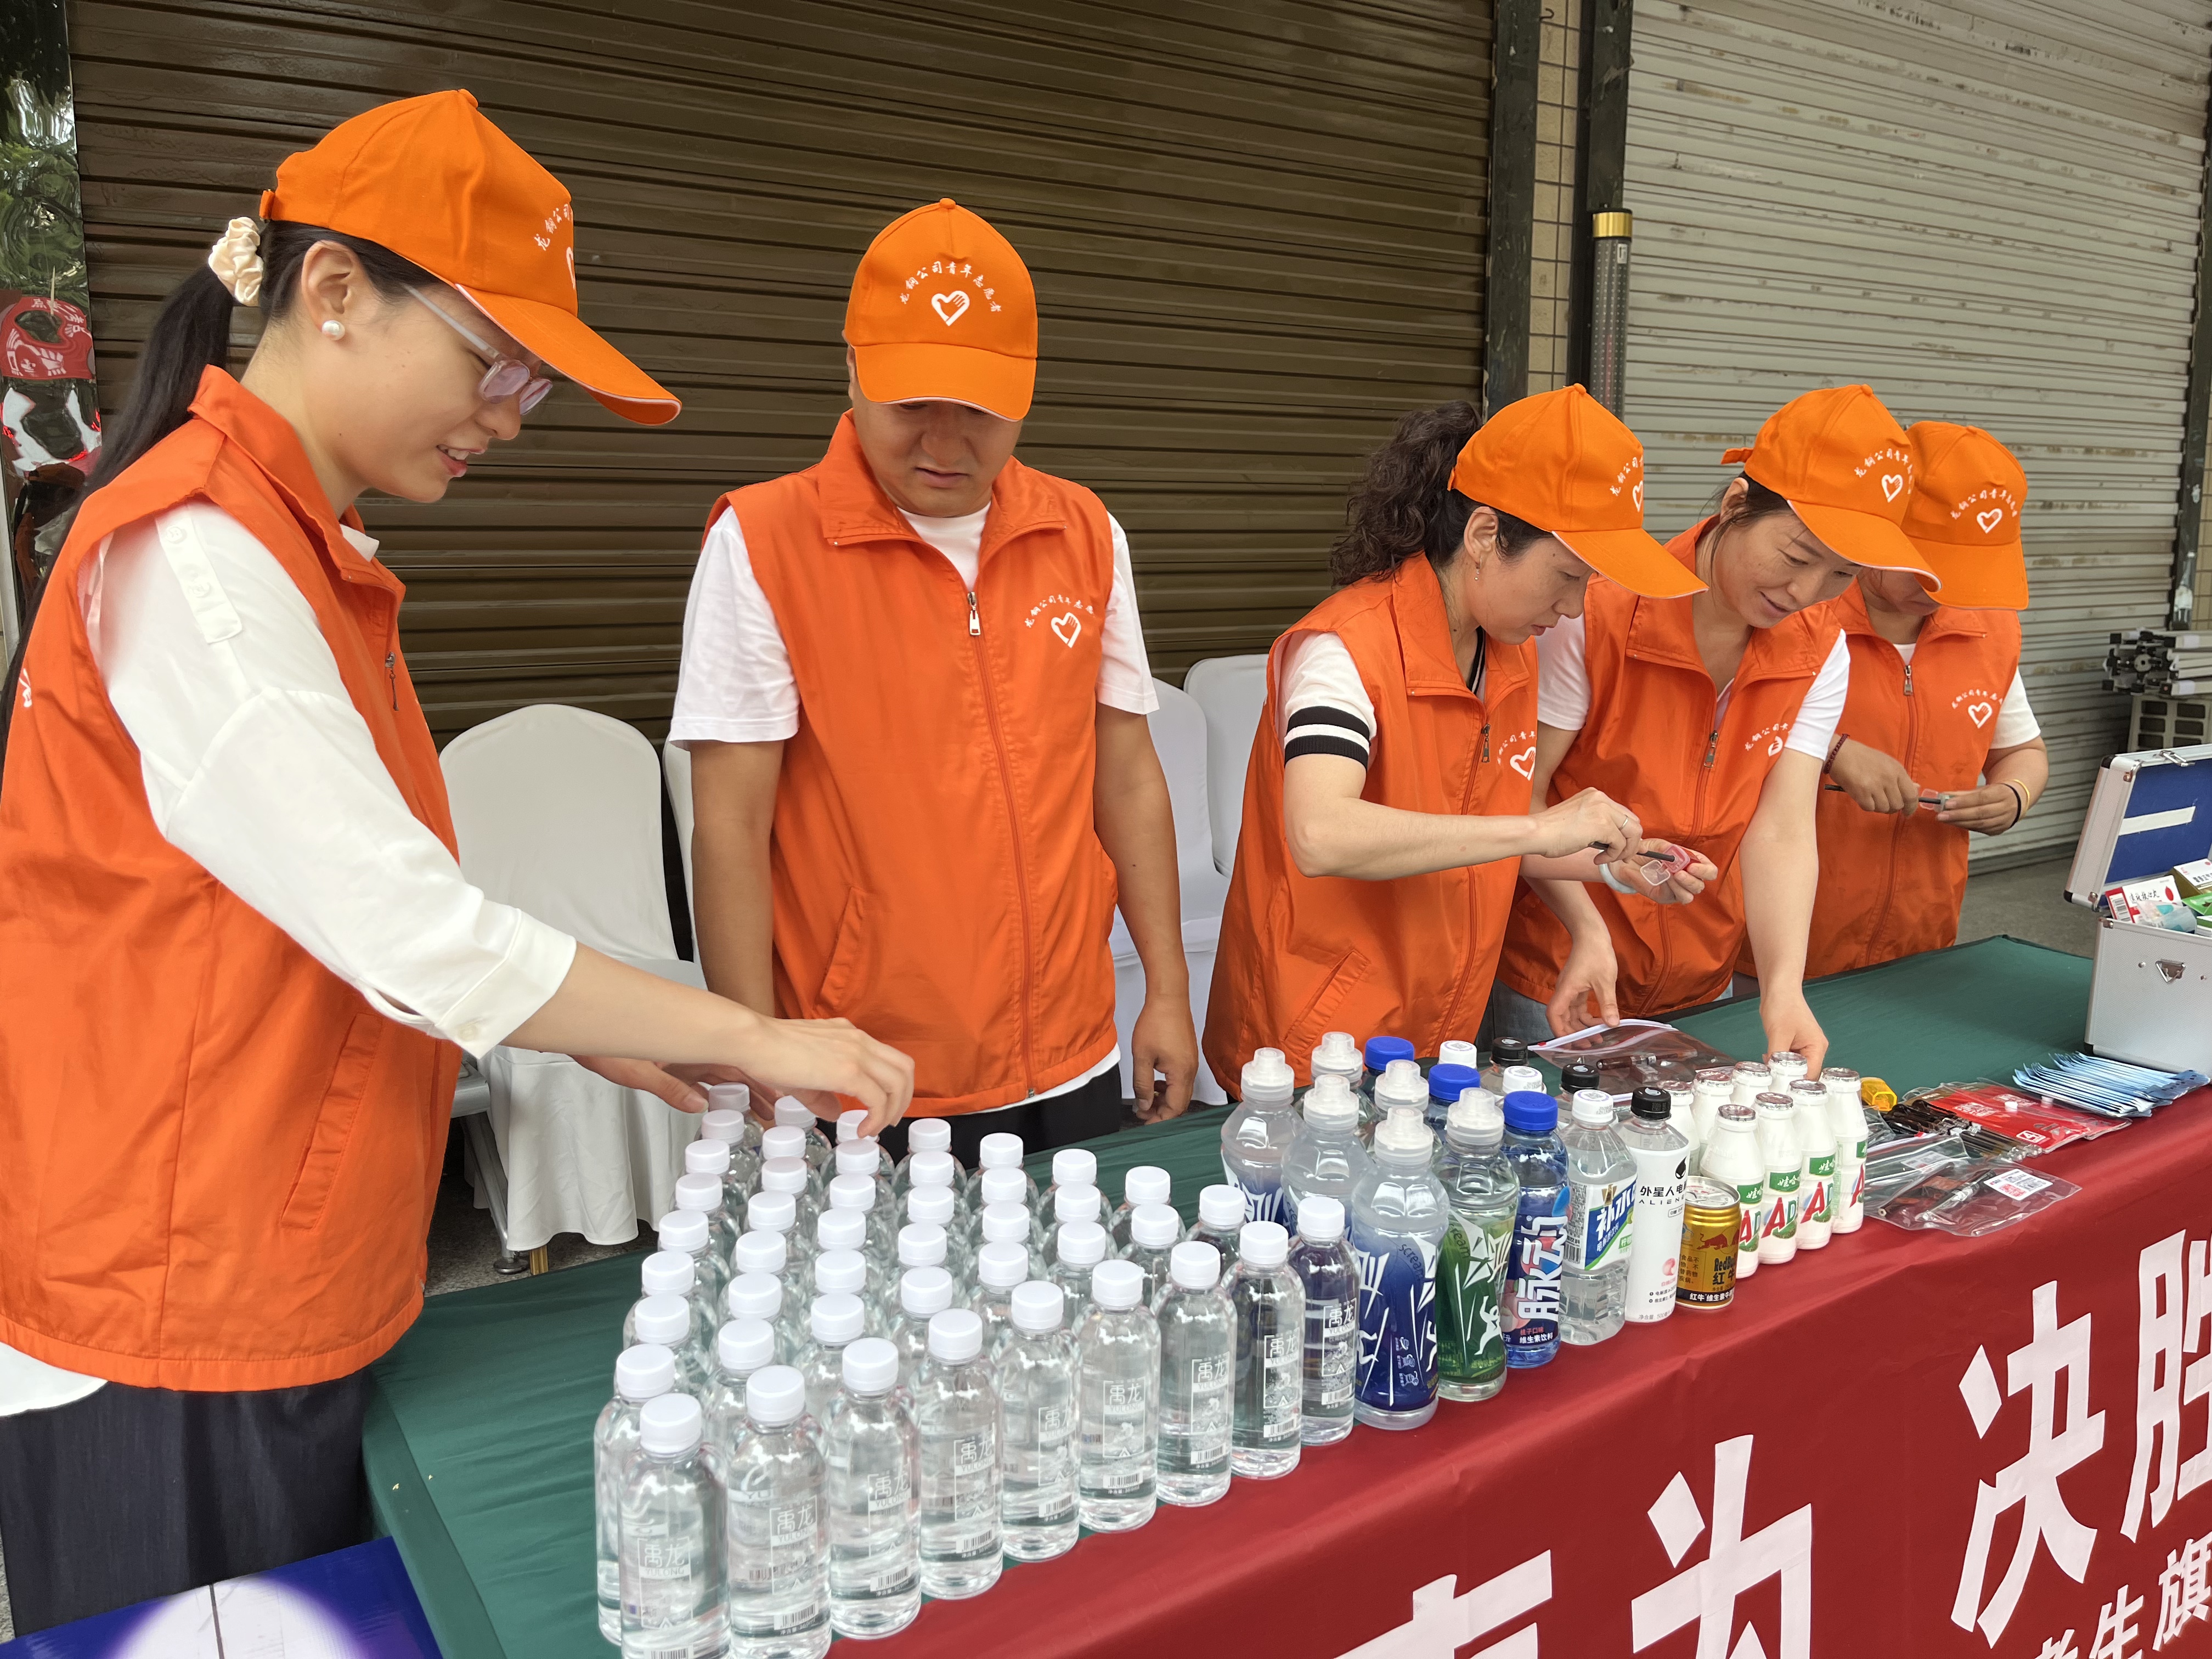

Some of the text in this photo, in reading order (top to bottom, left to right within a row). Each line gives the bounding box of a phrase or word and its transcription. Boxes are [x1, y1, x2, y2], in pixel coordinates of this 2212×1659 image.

[1777, 1174, 1801, 1188] 娃哈
[1760, 1197, 1799, 1239] AD
[1519, 1332, 1553, 1344] 维生素饮料
[1109, 1383, 1142, 1405] 禹龙
[777, 1504, 813, 1535] 禹龙
[644, 1544, 685, 1567] 禹龙
